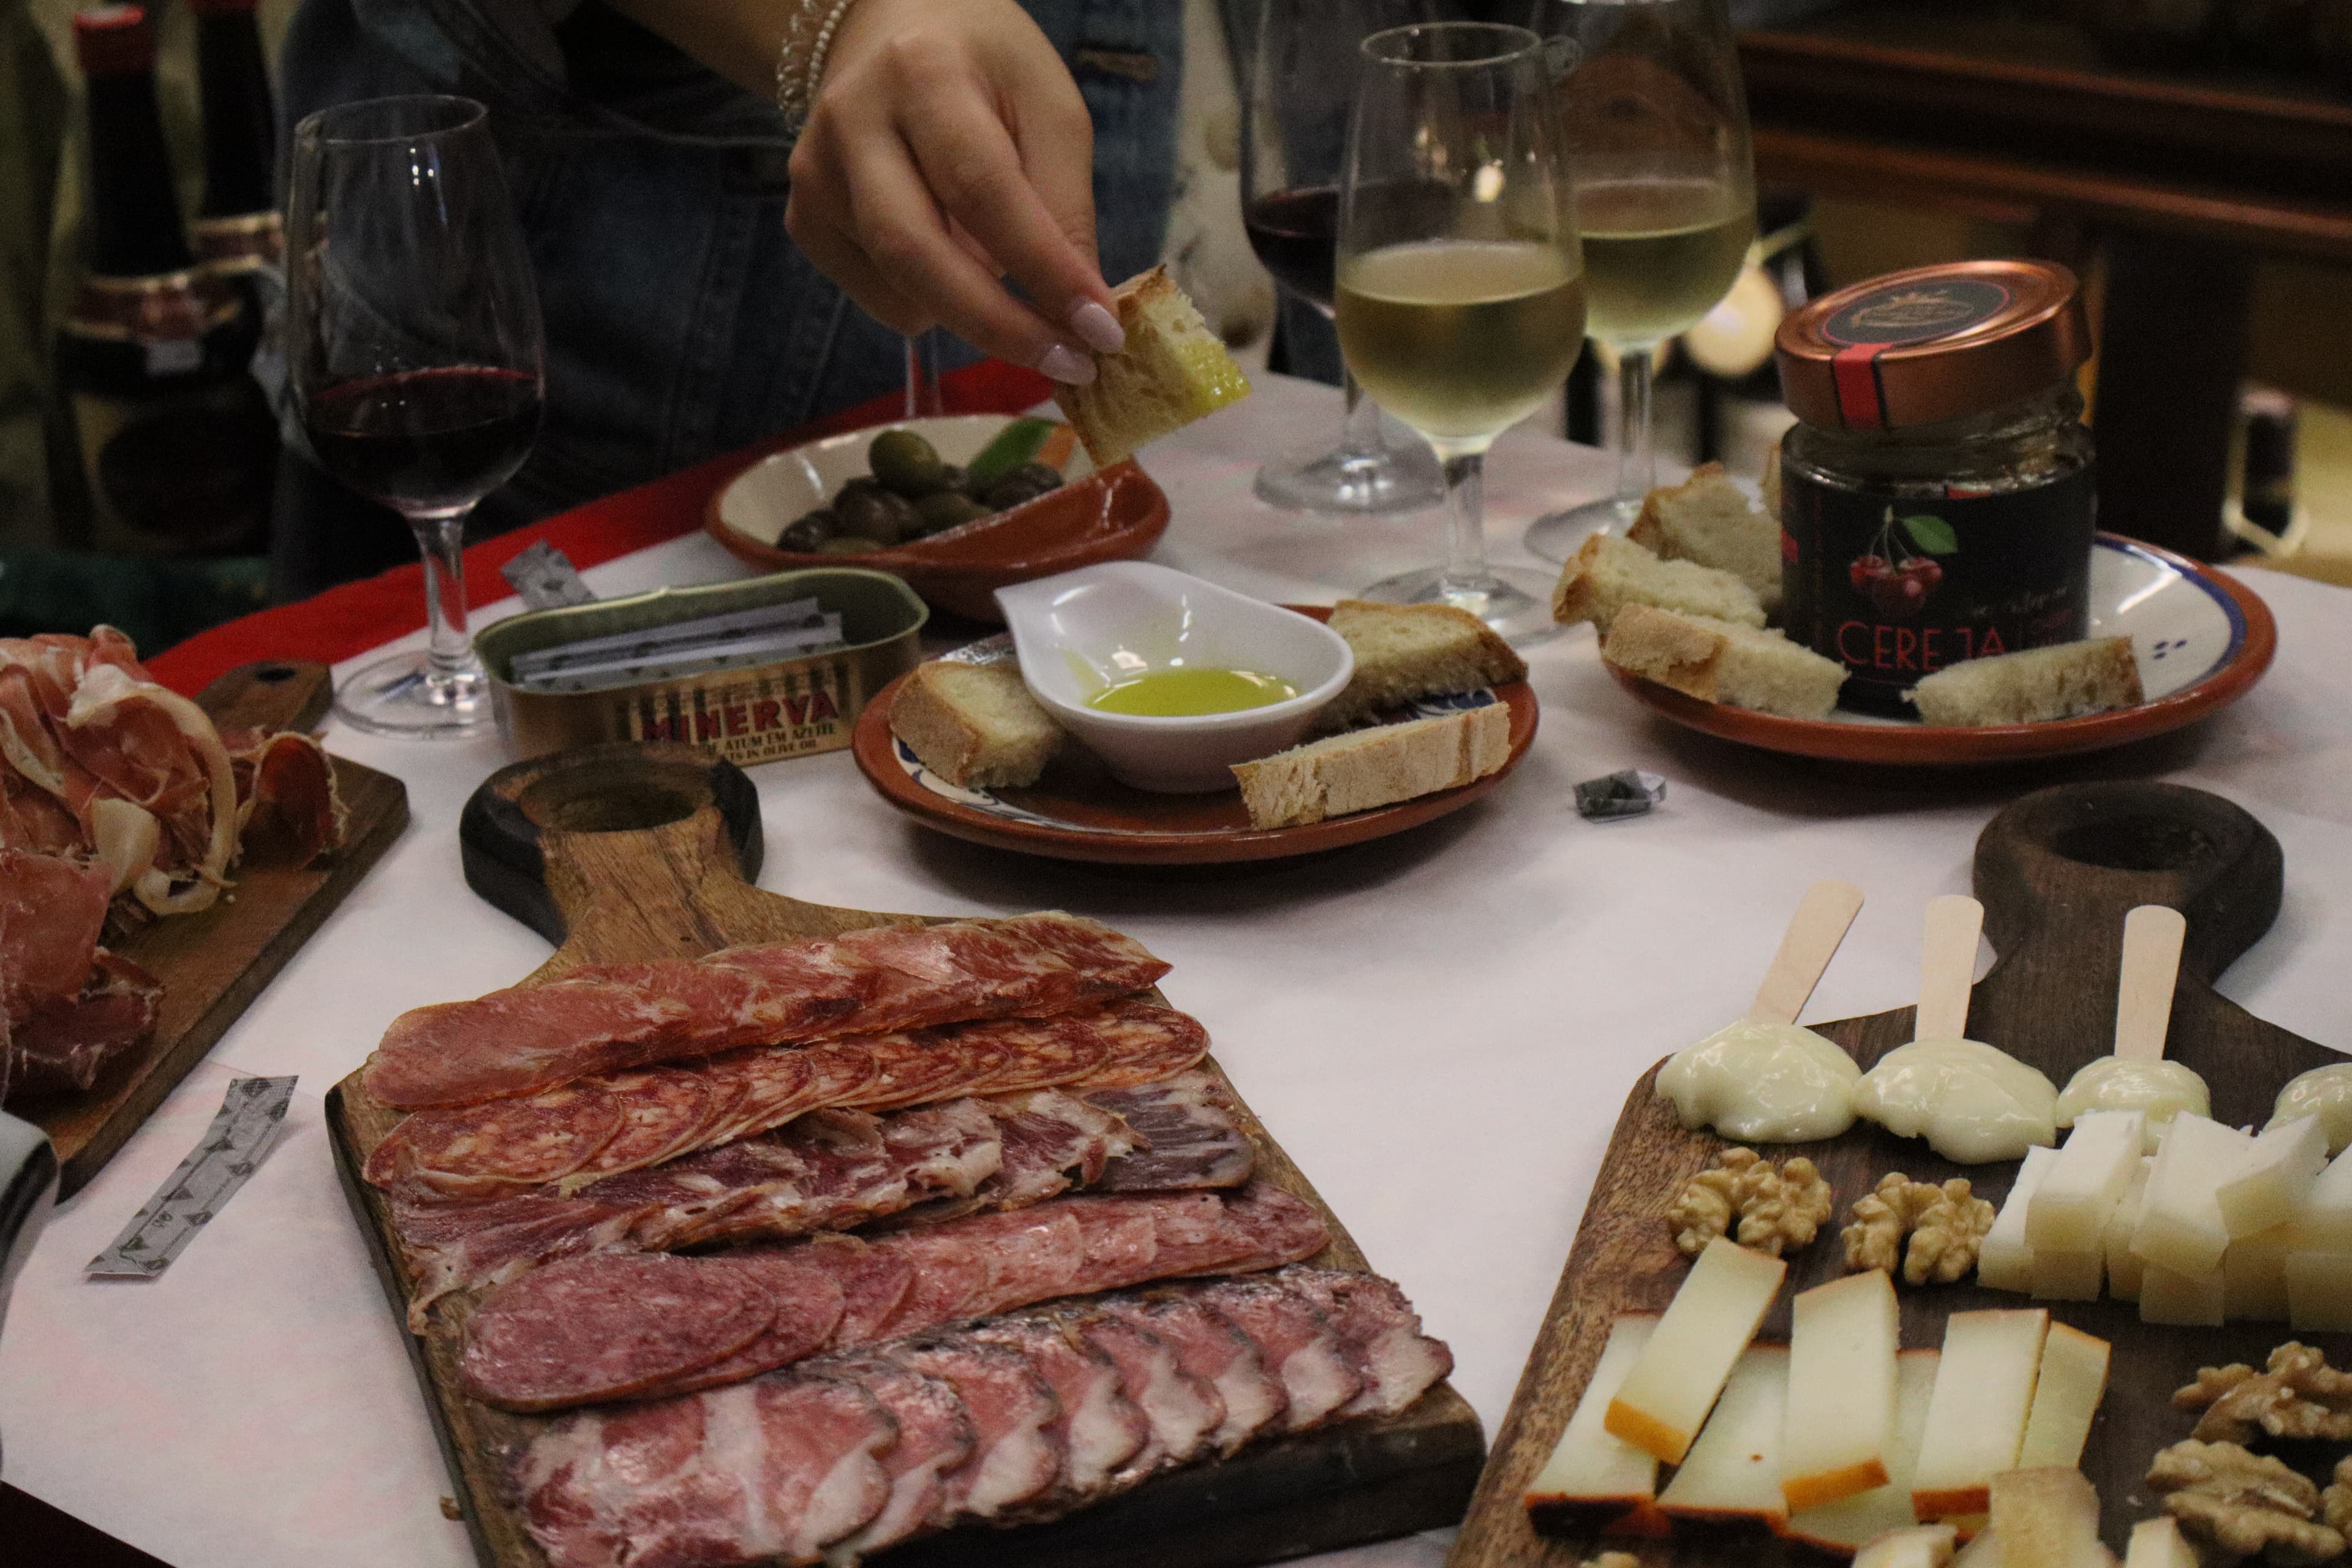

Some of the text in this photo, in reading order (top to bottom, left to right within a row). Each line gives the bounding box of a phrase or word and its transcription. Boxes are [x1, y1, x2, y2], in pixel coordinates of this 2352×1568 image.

[1838, 620, 2006, 671] CEREJA
[641, 690, 839, 742] MINERVA
[725, 736, 763, 751] ATUM
